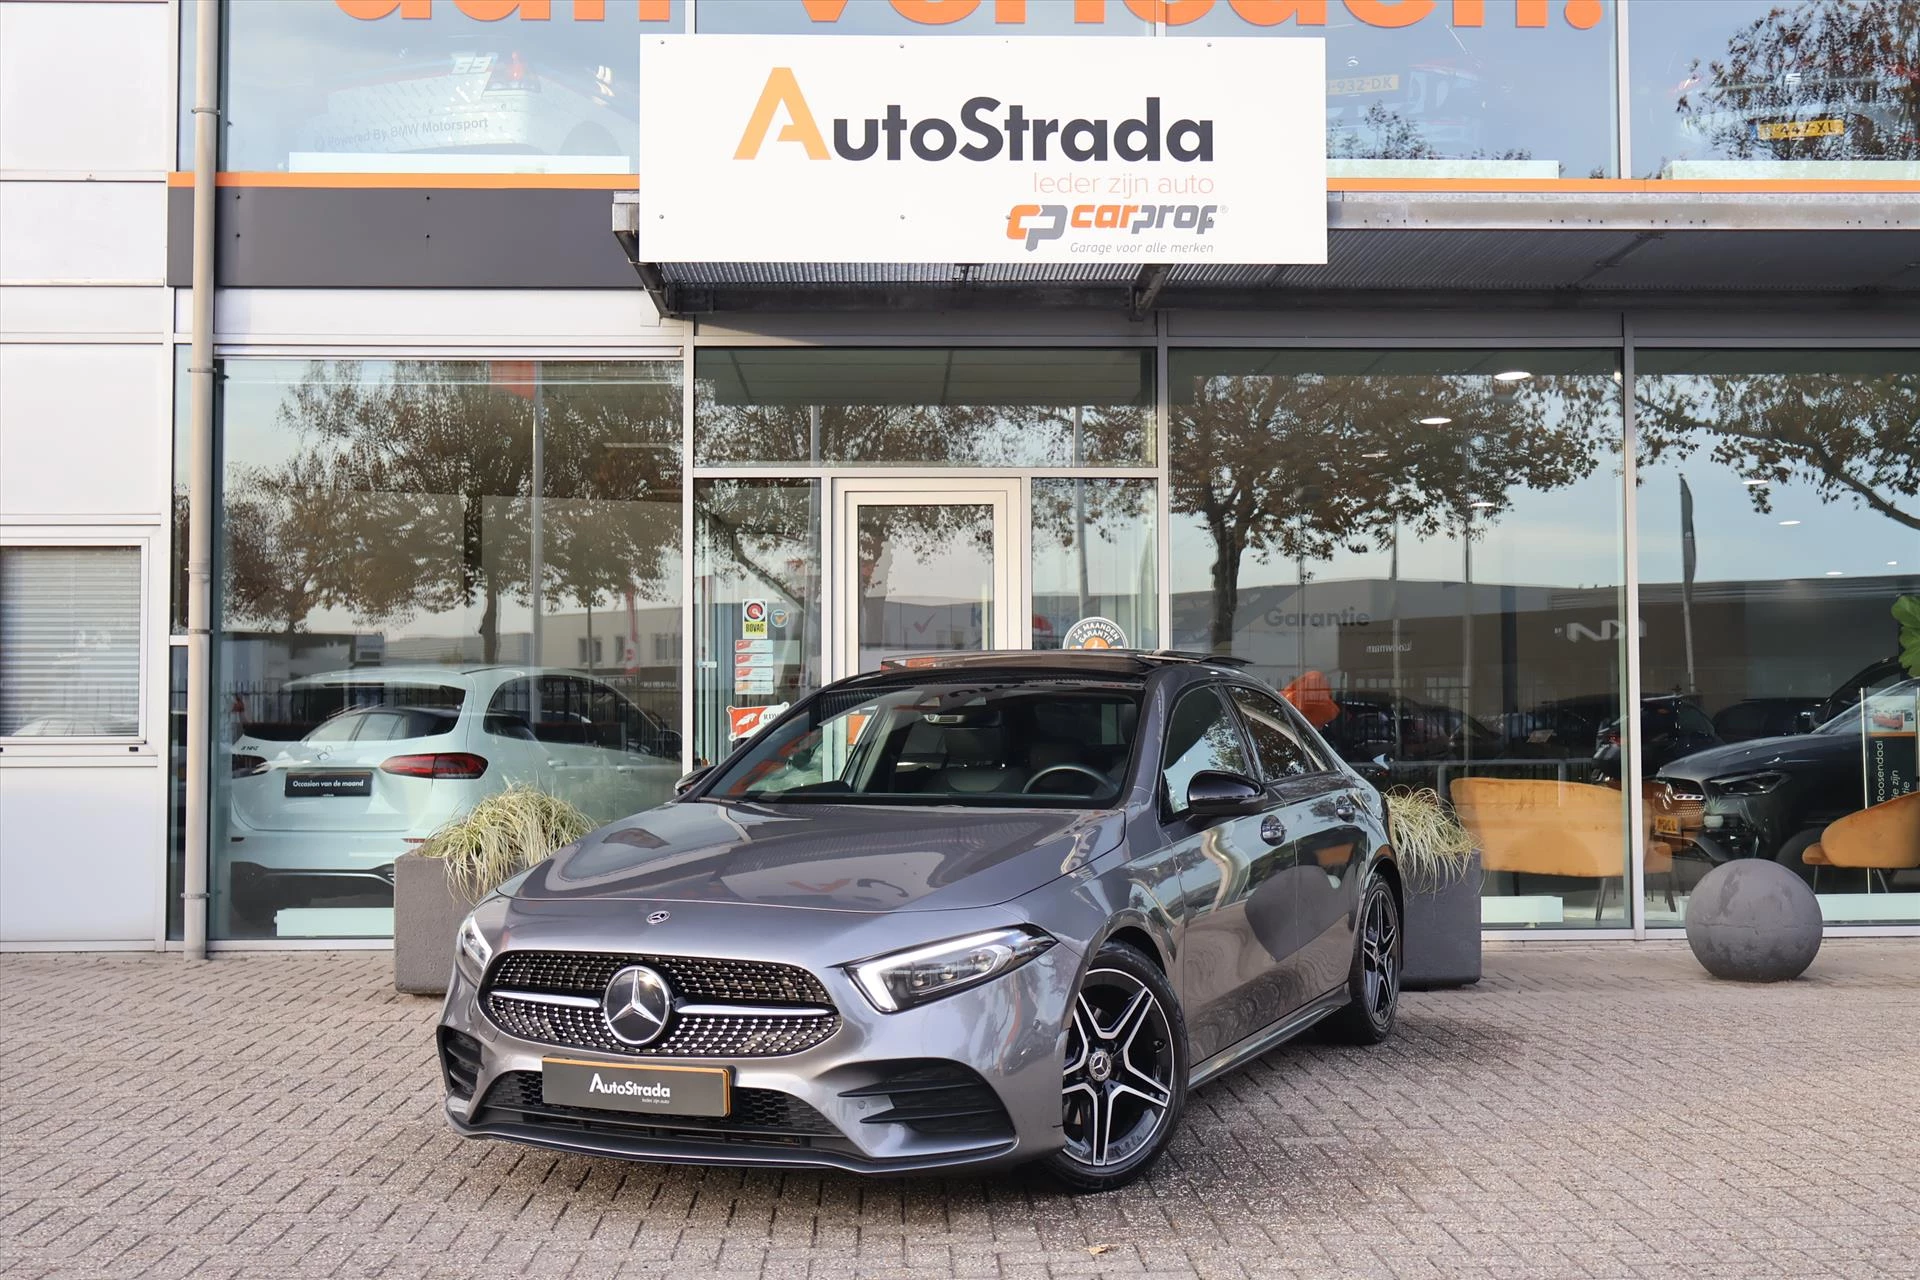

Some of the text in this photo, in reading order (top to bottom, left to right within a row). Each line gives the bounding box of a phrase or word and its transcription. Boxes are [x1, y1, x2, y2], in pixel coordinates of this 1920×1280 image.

[732, 67, 1214, 162] AutoStrada
[390, 123, 420, 138] BMW
[422, 117, 489, 132] Motorsport
[1033, 172, 1214, 199] Ieder zijn auto
[1070, 242, 1214, 255] Garage voor alle merken
[1264, 606, 1370, 628] Garantie
[745, 623, 765, 633] BOVAG
[1072, 622, 1120, 640] 24 MAANDEN
[1078, 629, 1115, 645] GARANTIE
[1875, 740, 1885, 802] Roosendaal
[1890, 769, 1900, 786] zijn
[589, 1072, 671, 1097] AutoStrada
